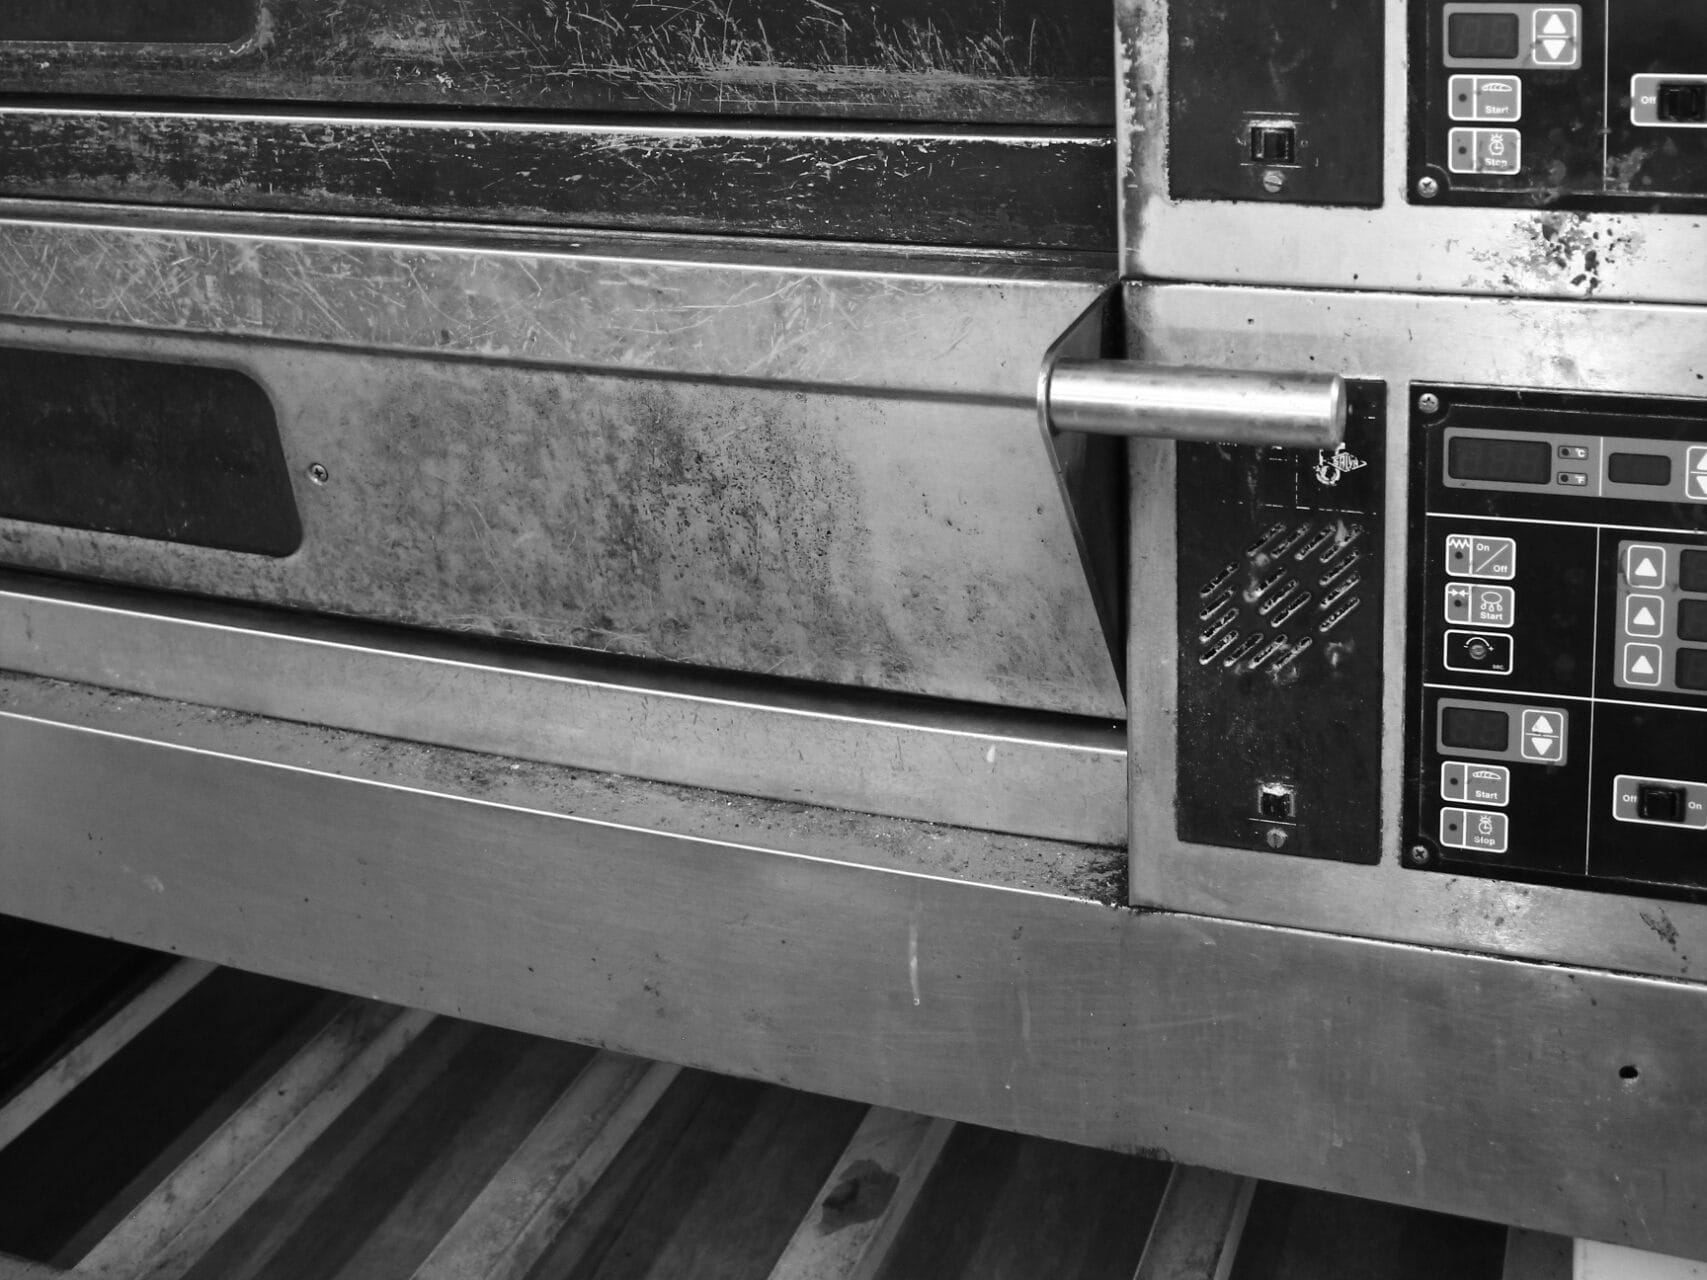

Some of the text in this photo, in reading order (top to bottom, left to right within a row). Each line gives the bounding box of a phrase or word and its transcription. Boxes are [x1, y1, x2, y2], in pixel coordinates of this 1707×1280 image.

[1485, 105, 1510, 115] Start
[1475, 542, 1491, 553] On
[1492, 563, 1508, 574] Off
[1479, 610, 1503, 622] Start
[1474, 789, 1499, 801] Start
[1622, 793, 1638, 804] Off
[1687, 801, 1703, 811] On
[1473, 835, 1496, 847] Stop
